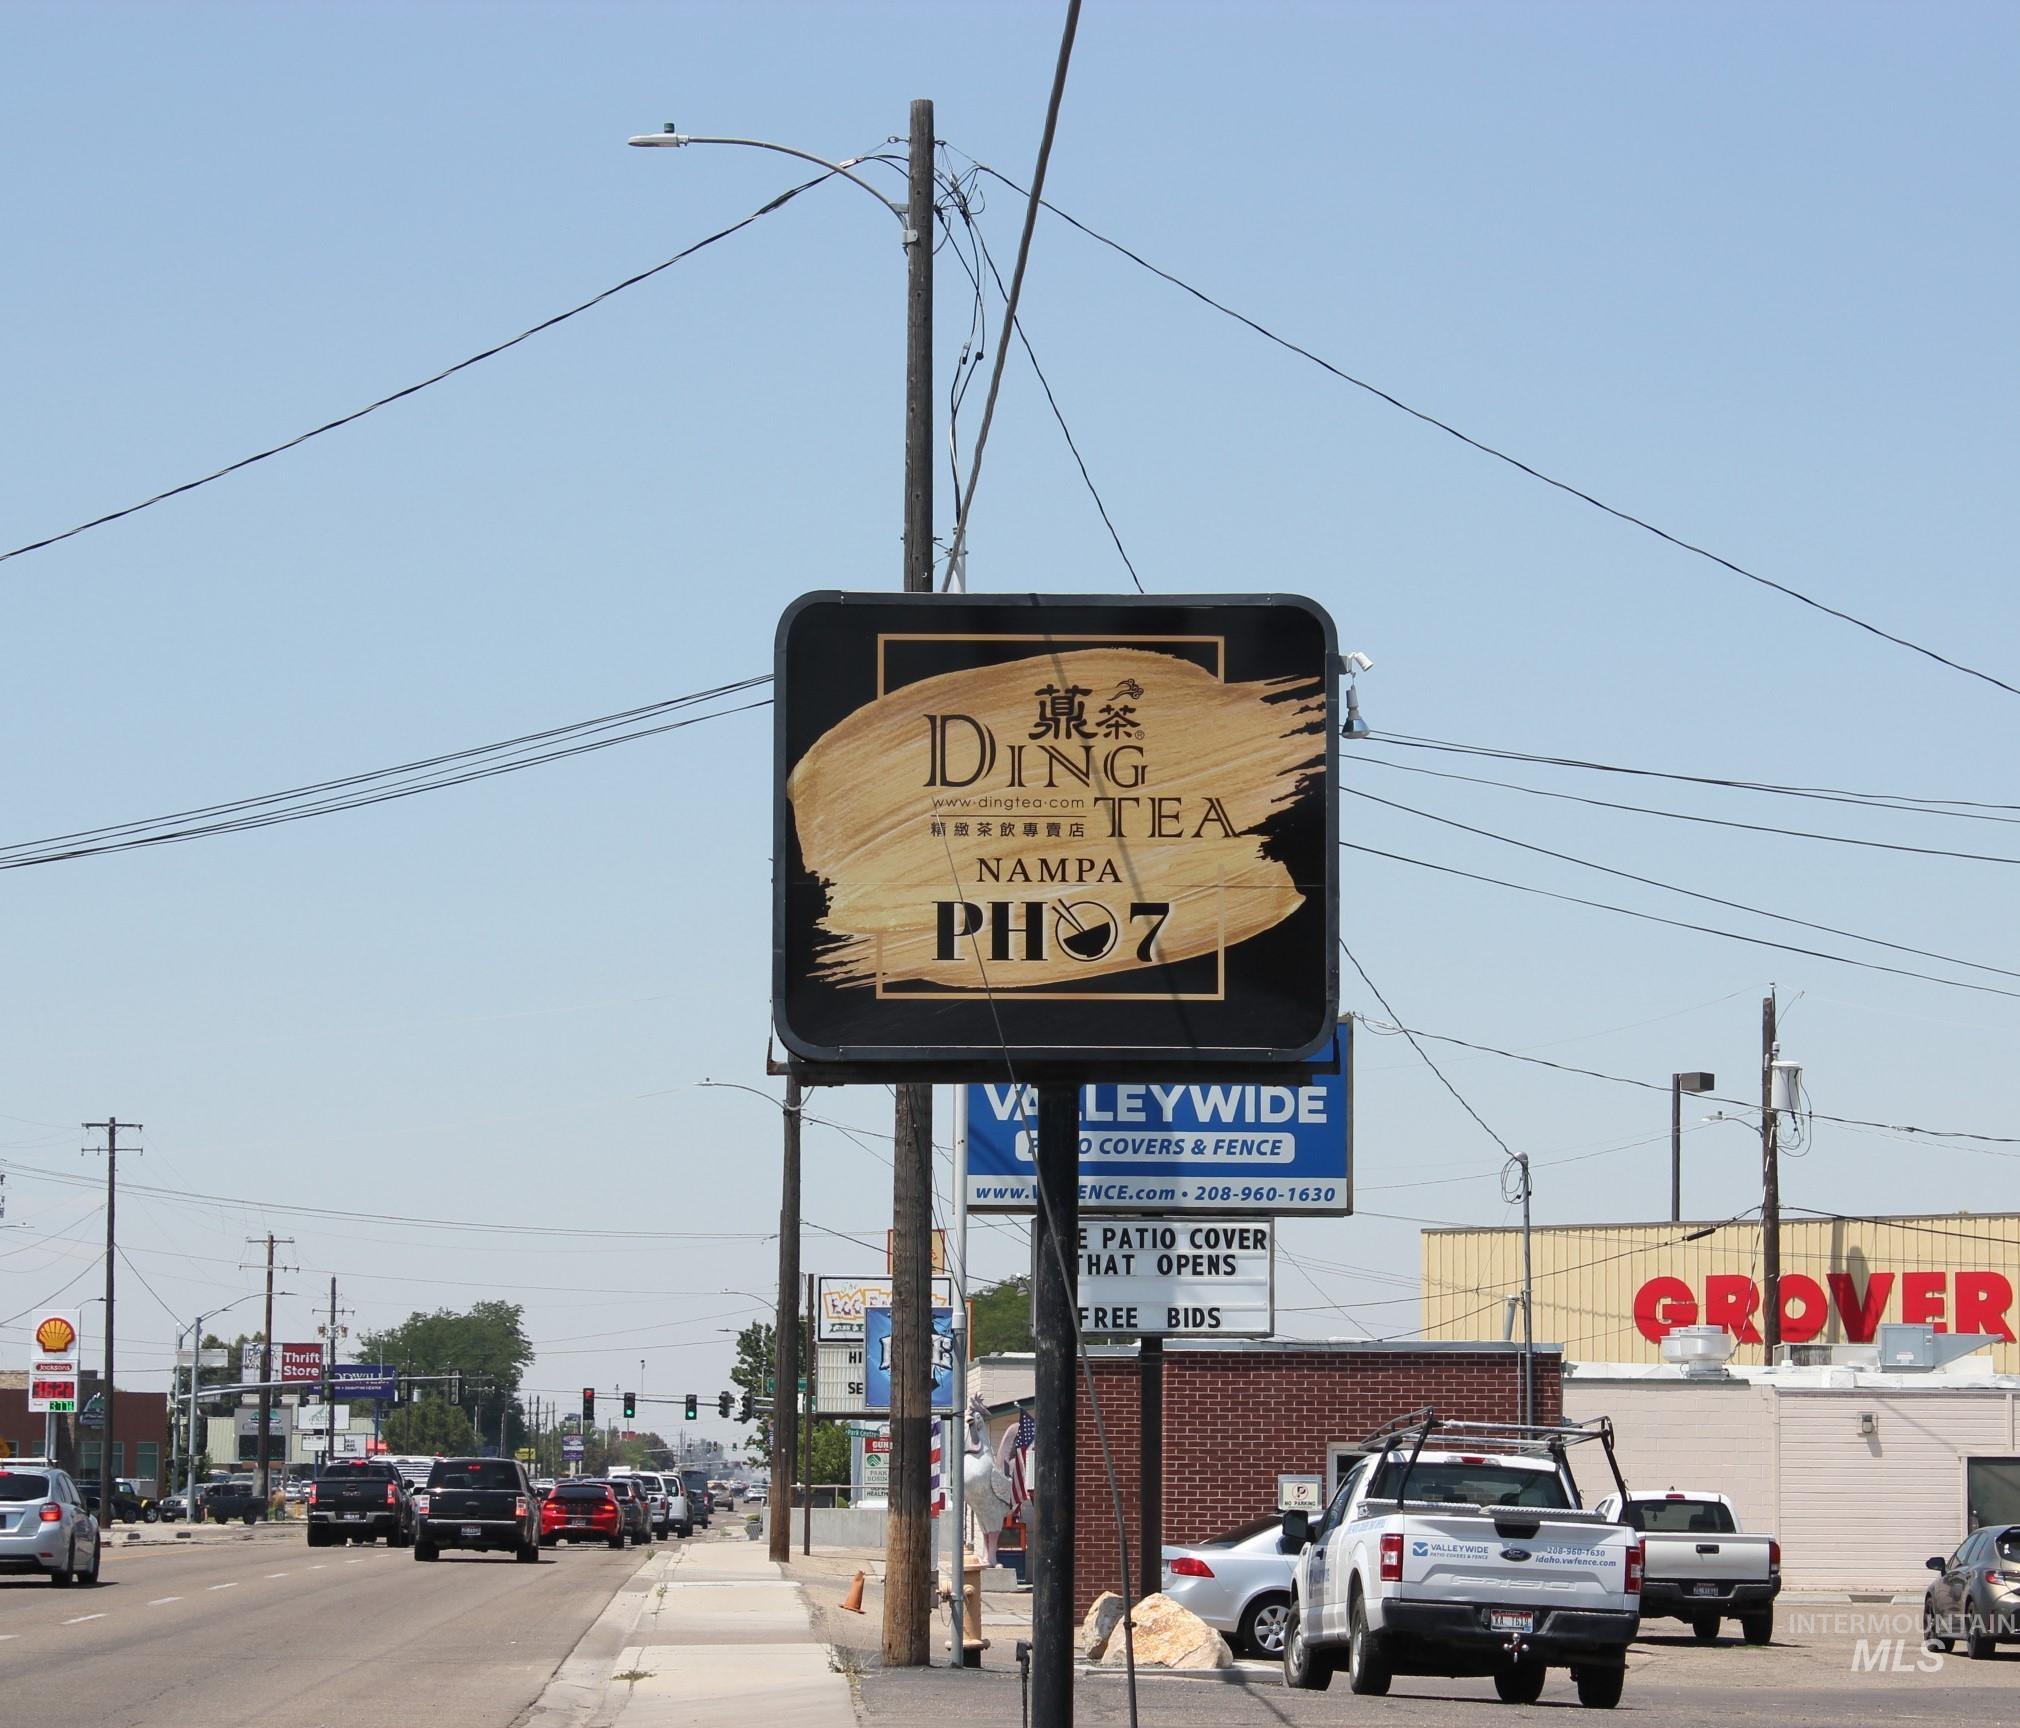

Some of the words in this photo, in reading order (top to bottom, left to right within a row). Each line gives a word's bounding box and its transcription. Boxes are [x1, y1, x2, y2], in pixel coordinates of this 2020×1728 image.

[1093, 796, 1240, 838] TEA
[976, 857, 1123, 884] NAMPA
[1129, 901, 1171, 964] 7
[983, 1083, 1328, 1124] VALEYWIDE
[1099, 1138, 1185, 1155] COVERS
[1190, 1138, 1208, 1156] &
[1212, 1139, 1283, 1156] FENCE
[1194, 1186, 1336, 1202] 208-960-1630
[1102, 1227, 1176, 1250] PATIO
[1189, 1227, 1267, 1250] COVER
[1157, 1254, 1237, 1276] OPENS
[1079, 1307, 1138, 1329] FREE
[1167, 1307, 1221, 1329] BIDS
[1633, 1271, 2017, 1345] GROVER
[284, 1351, 320, 1364] Thrift
[283, 1365, 320, 1377] Store
[1430, 1543, 1489, 1554] VALLEYWIDE
[1547, 1546, 1606, 1557] 208-960-1630
[1535, 1554, 1617, 1567] idaho.vwfence.com
